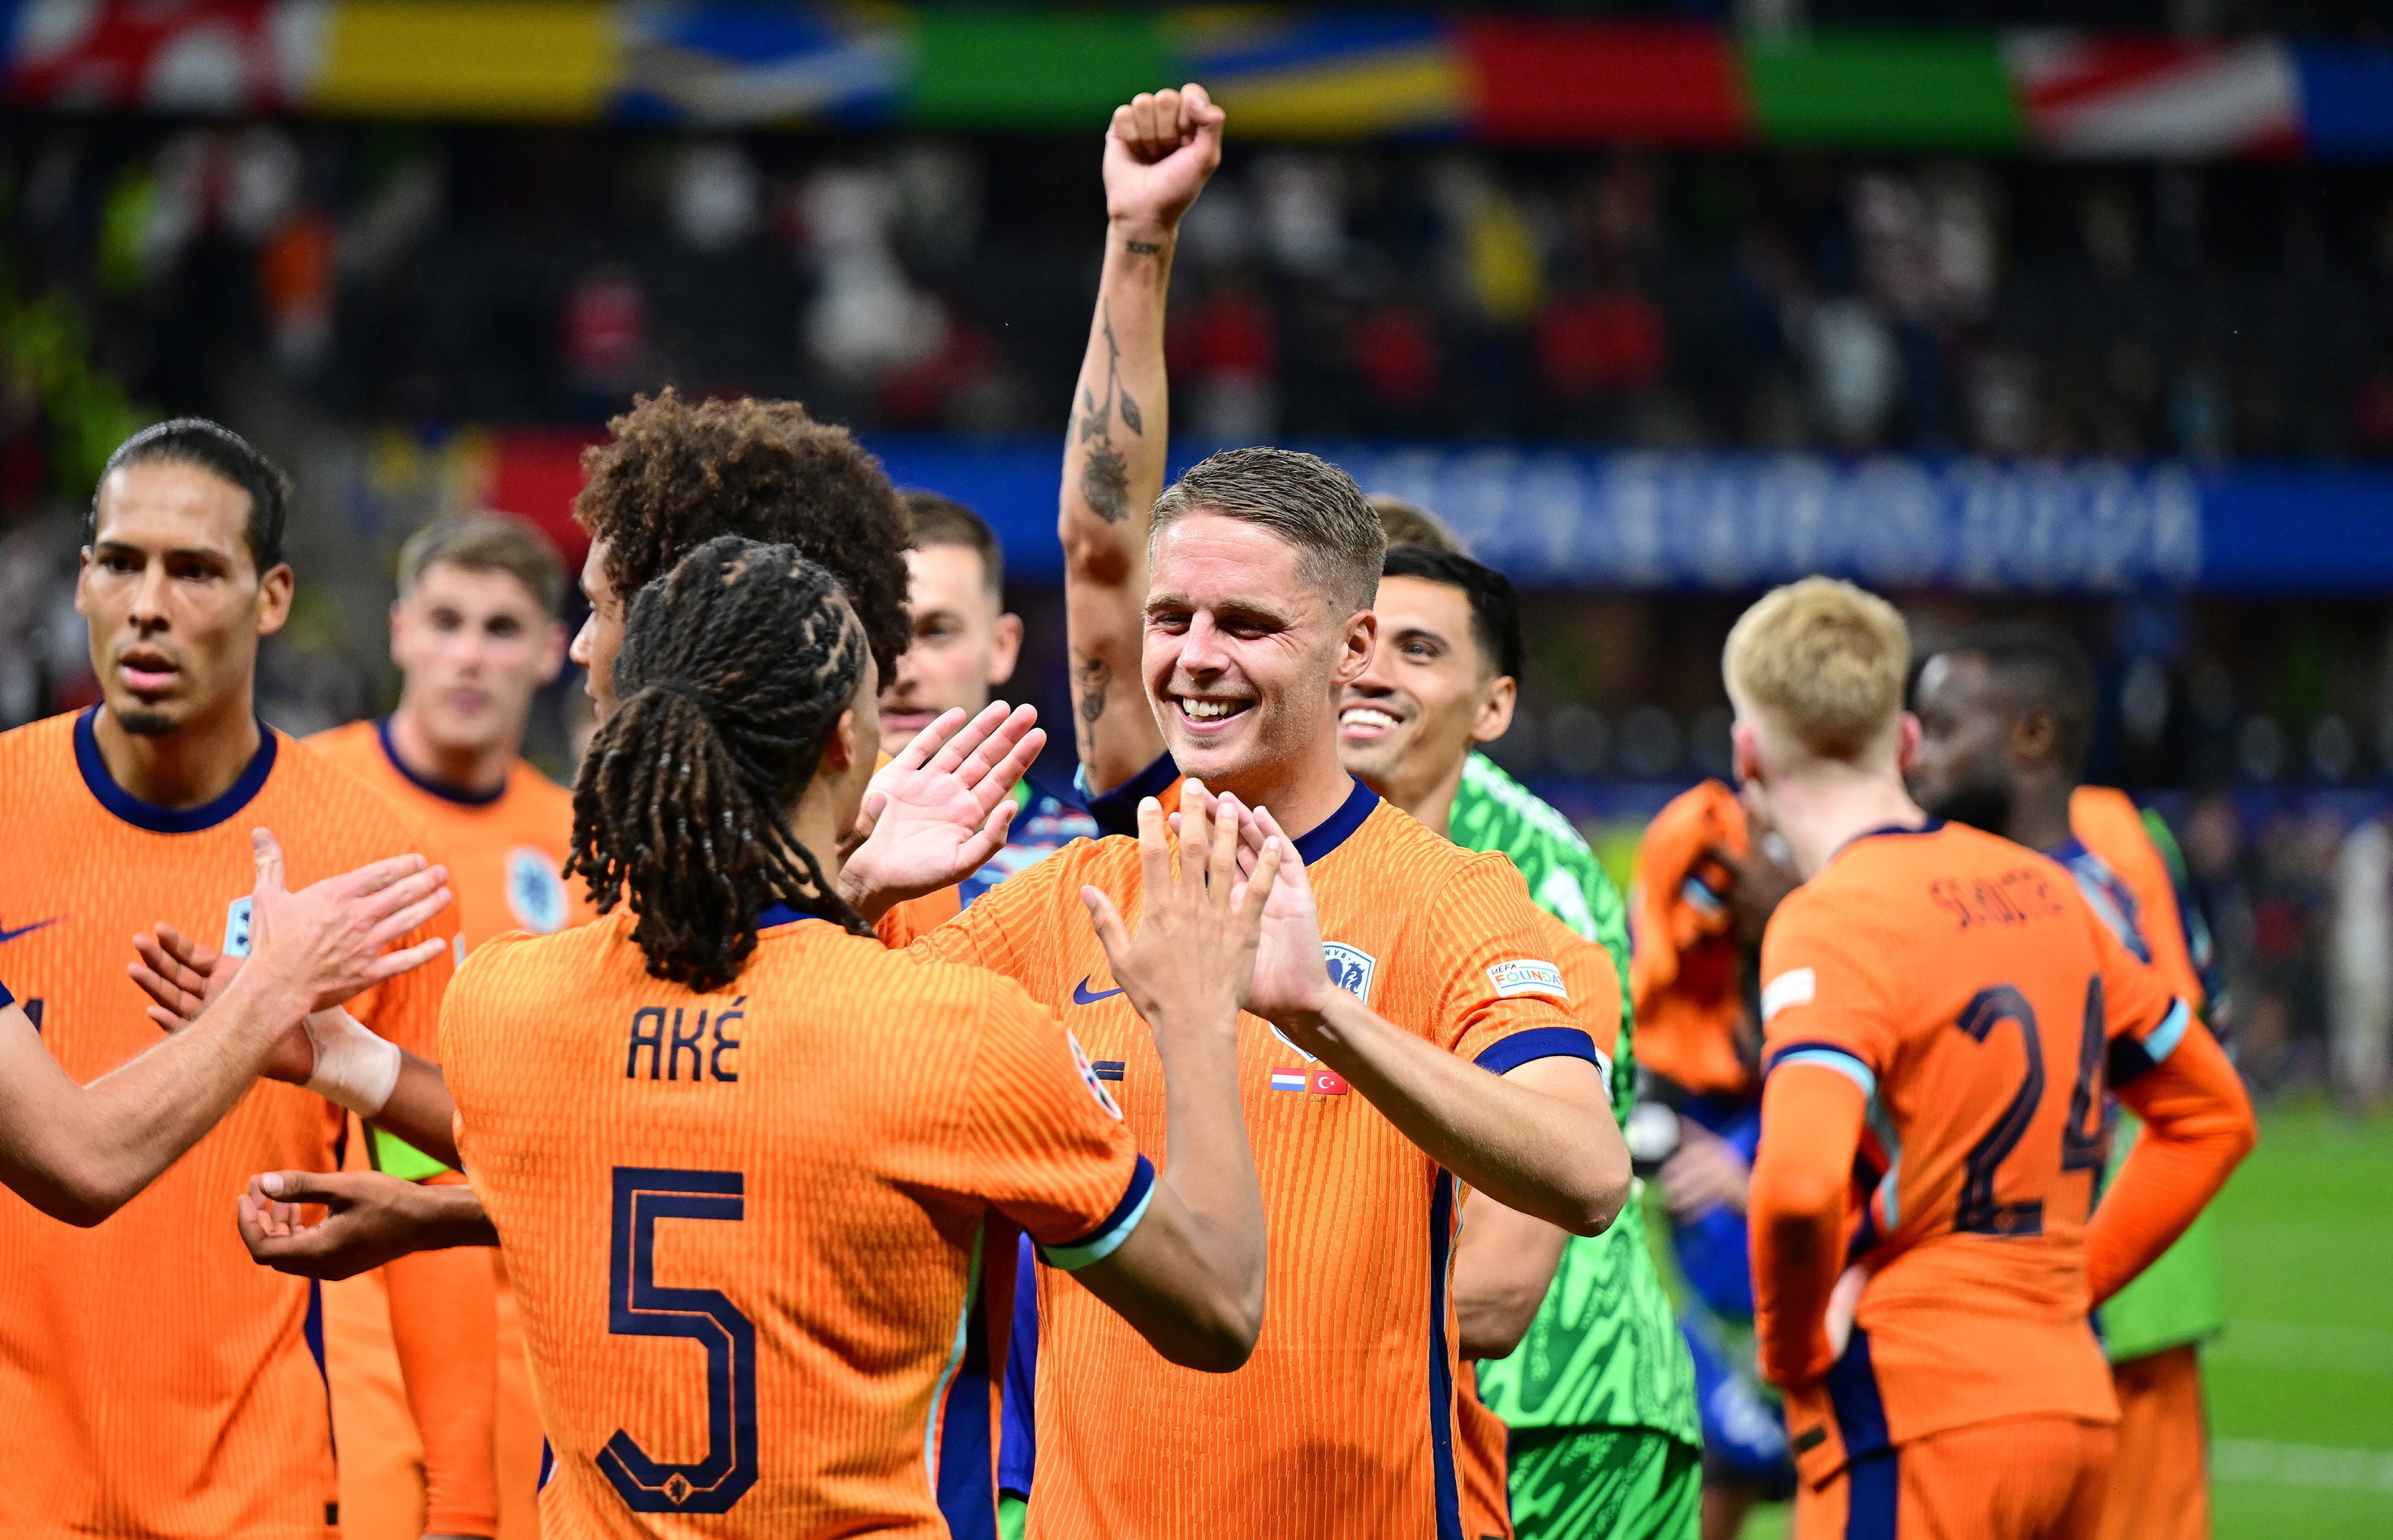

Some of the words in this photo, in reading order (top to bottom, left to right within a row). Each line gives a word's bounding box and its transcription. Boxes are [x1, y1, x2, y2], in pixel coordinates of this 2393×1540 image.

[626, 995, 748, 1082] AKÉ
[1491, 964, 1517, 975] UEFA
[1955, 974, 2106, 1236] 24
[595, 1167, 759, 1515] 5
